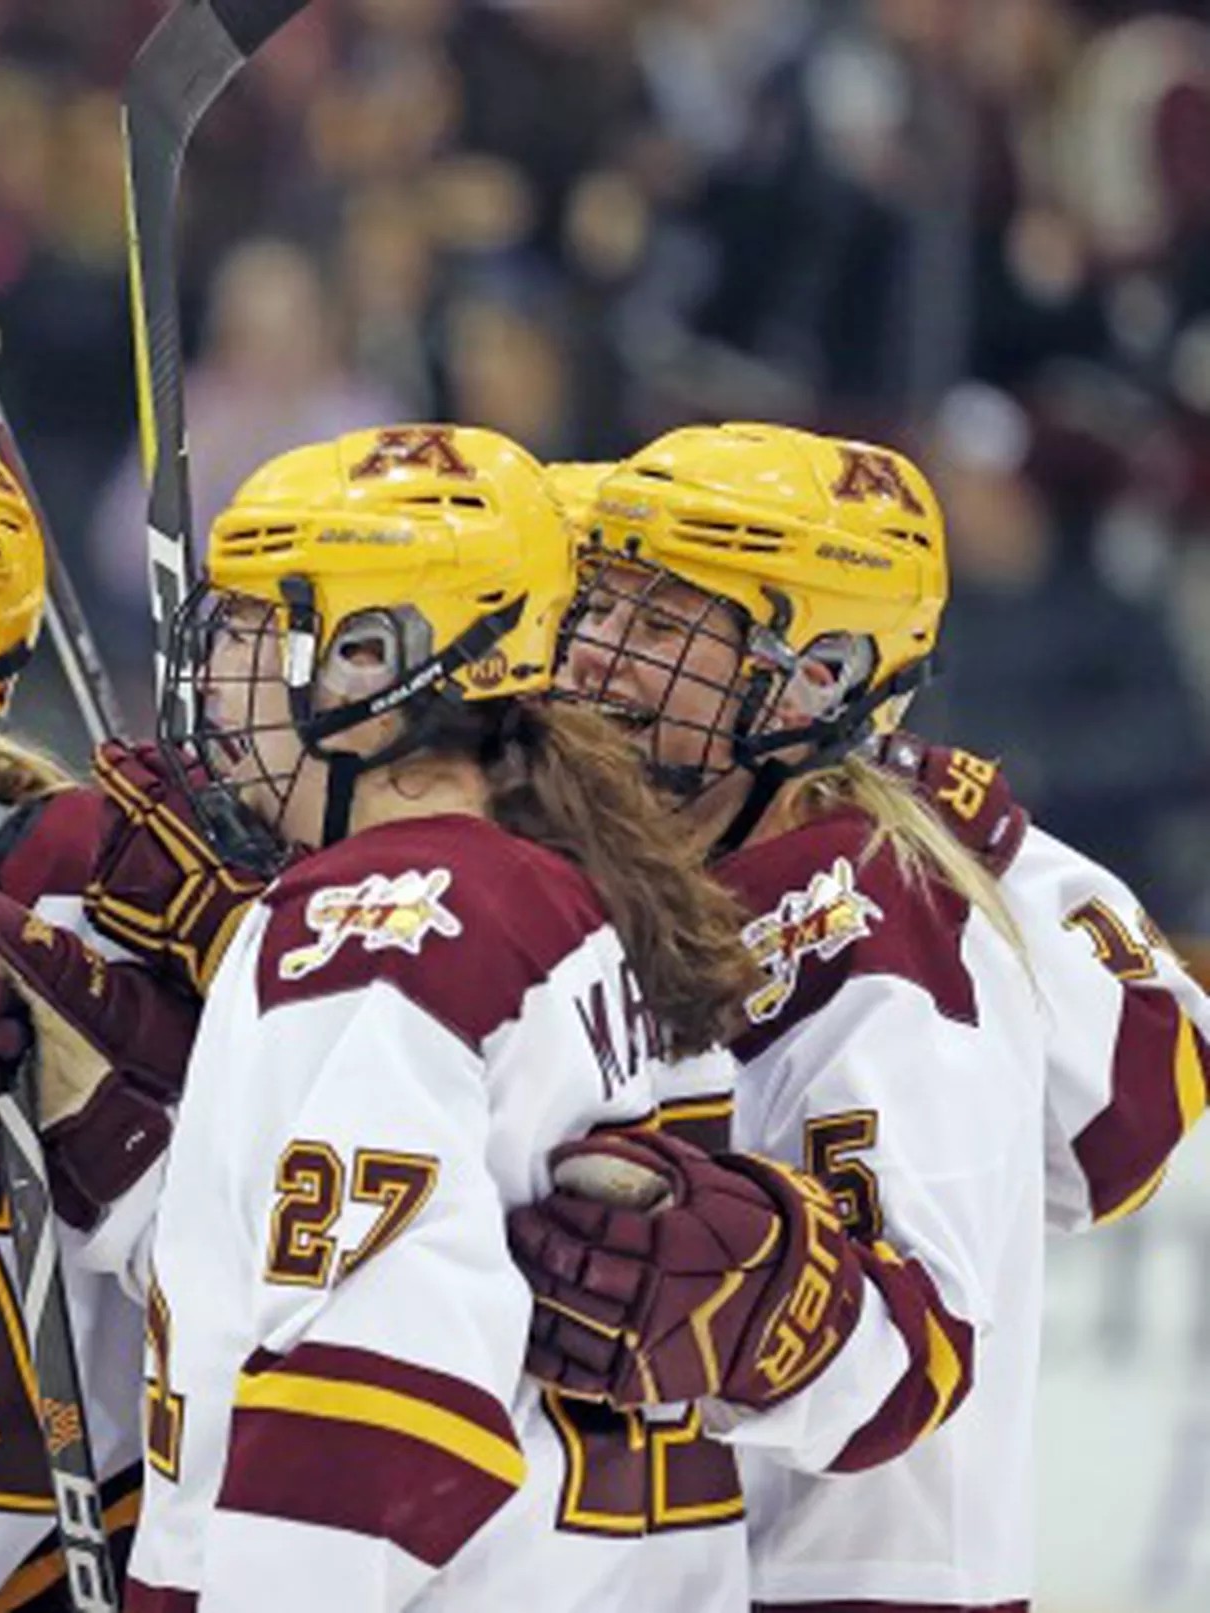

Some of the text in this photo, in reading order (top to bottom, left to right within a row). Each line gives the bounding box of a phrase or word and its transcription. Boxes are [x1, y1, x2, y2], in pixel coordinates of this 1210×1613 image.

[349, 427, 477, 480] M
[830, 447, 926, 517] M
[263, 1137, 441, 1290] 27
[803, 1108, 883, 1245] 5
